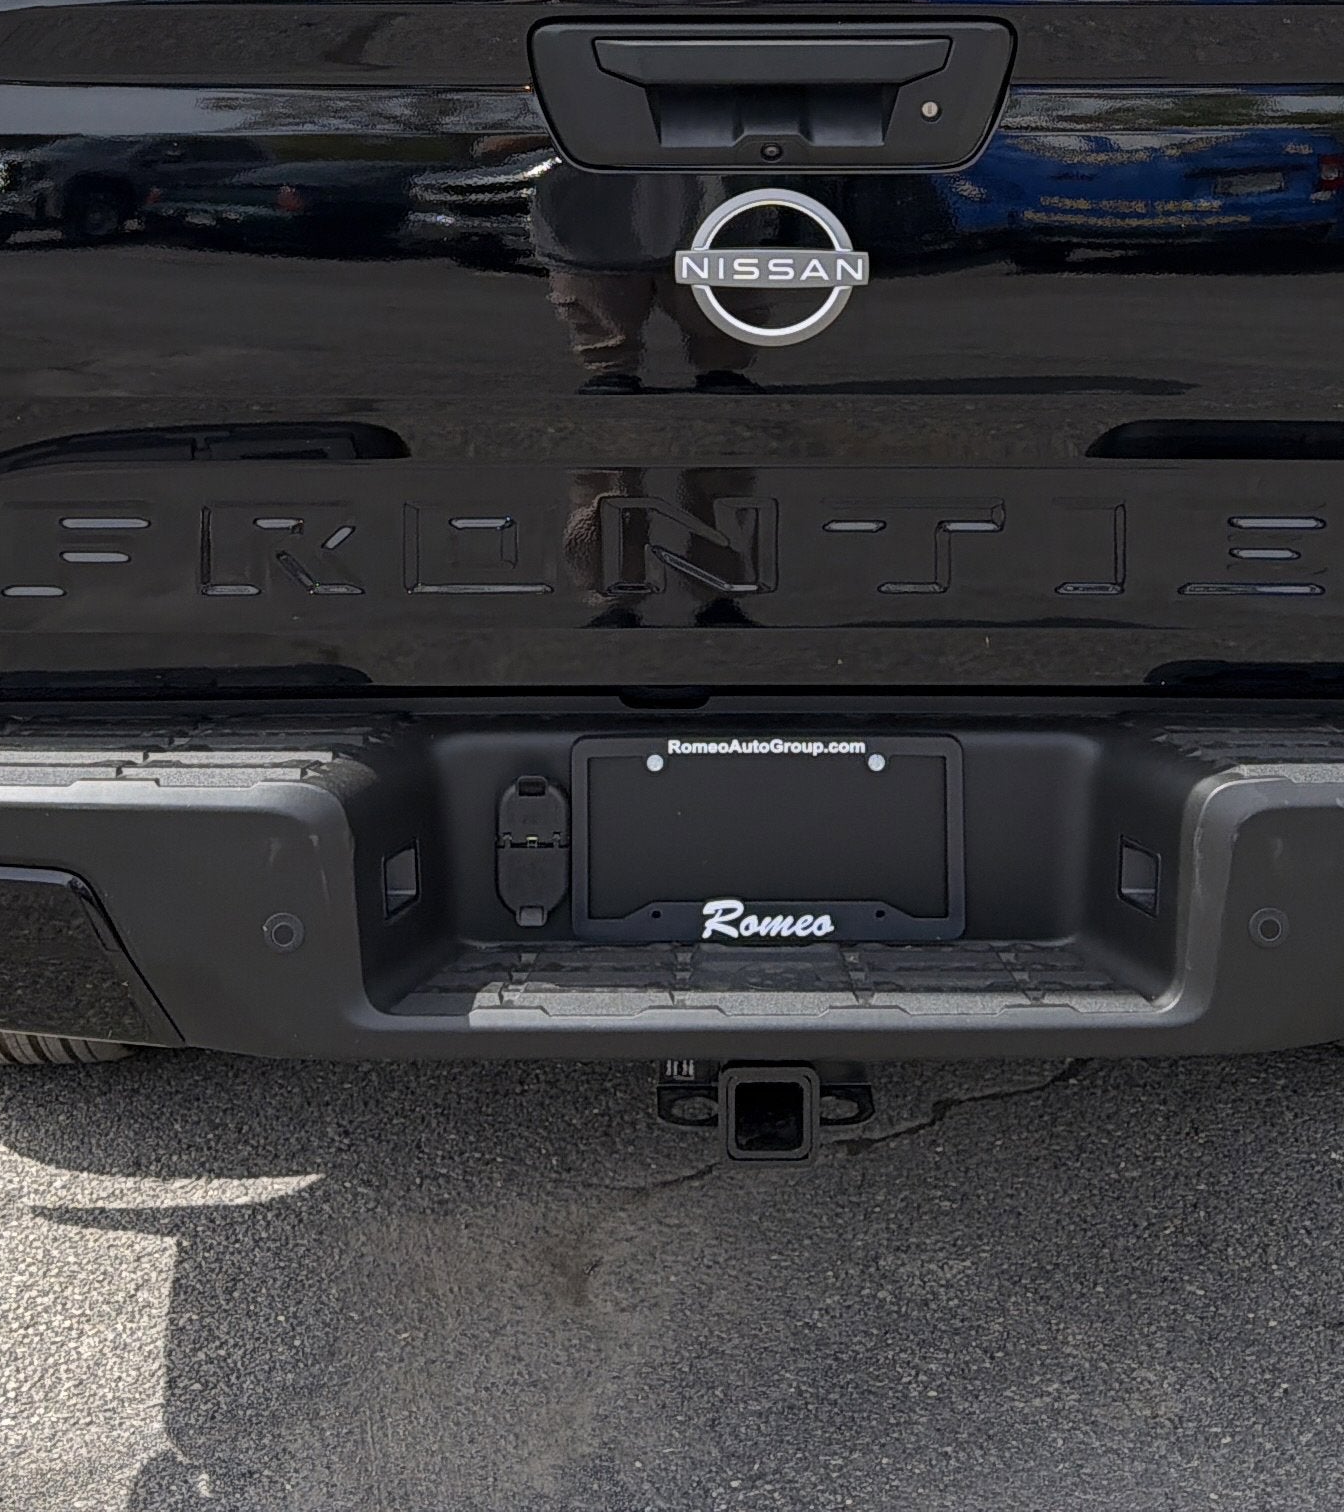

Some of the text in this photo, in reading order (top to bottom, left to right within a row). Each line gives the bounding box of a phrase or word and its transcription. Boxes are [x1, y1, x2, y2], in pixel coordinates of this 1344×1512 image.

[682, 257, 863, 282] NISSAN
[668, 739, 866, 756] RomeoAutoGroup.com
[702, 899, 834, 939] Romeo
